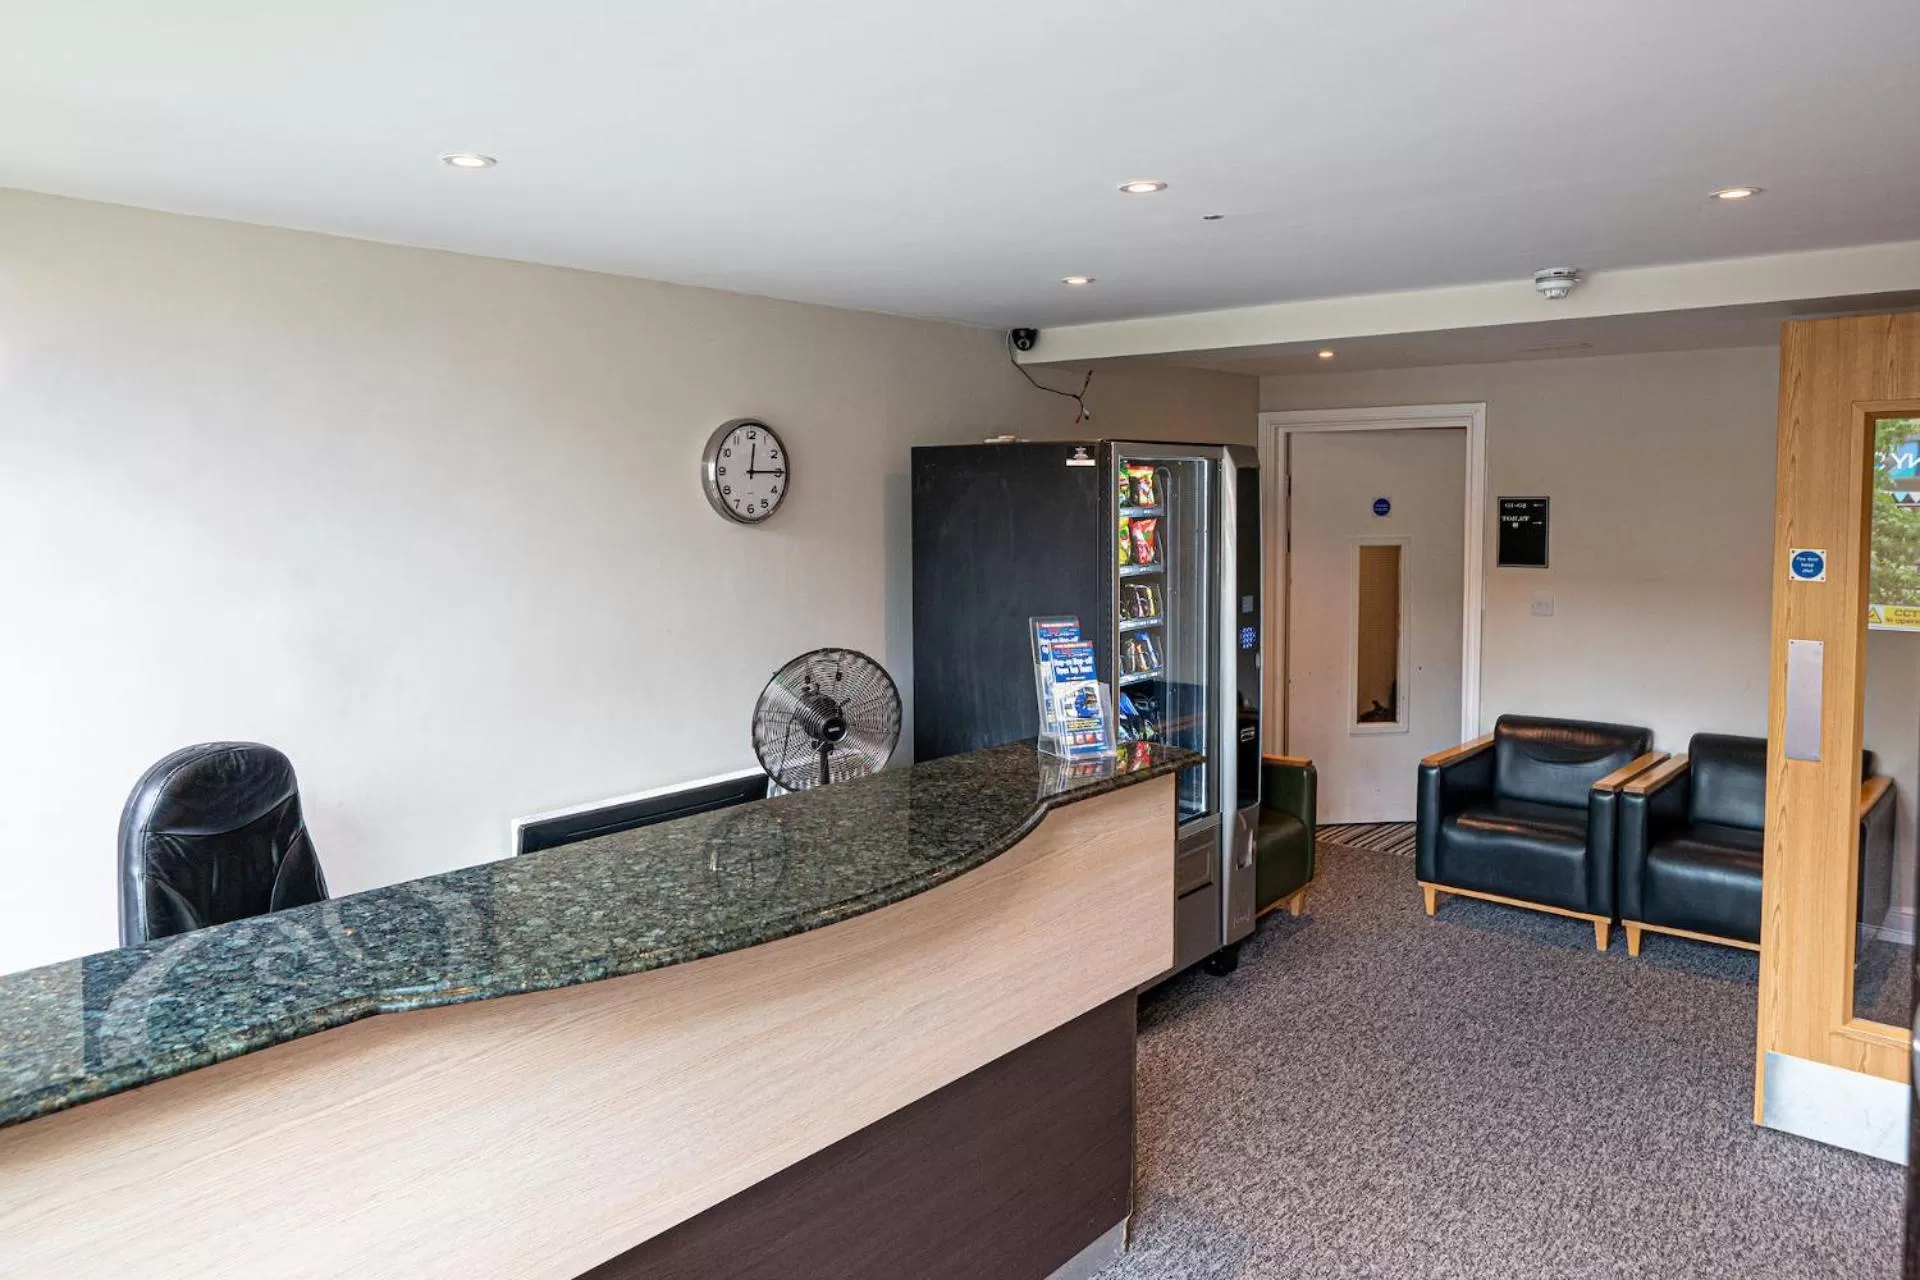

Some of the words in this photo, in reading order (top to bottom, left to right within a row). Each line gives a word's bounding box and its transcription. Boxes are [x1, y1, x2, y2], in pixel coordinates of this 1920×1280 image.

[734, 435, 740, 445] 11
[746, 431, 756, 439] 12
[724, 449, 732, 457] 10
[770, 450, 778, 459] 2
[718, 466, 726, 476] 9
[774, 468, 782, 478] 3
[723, 485, 731, 495] 8
[770, 485, 778, 494] 4
[734, 499, 741, 509] 7
[761, 498, 769, 508] 5
[747, 504, 755, 514] 6
